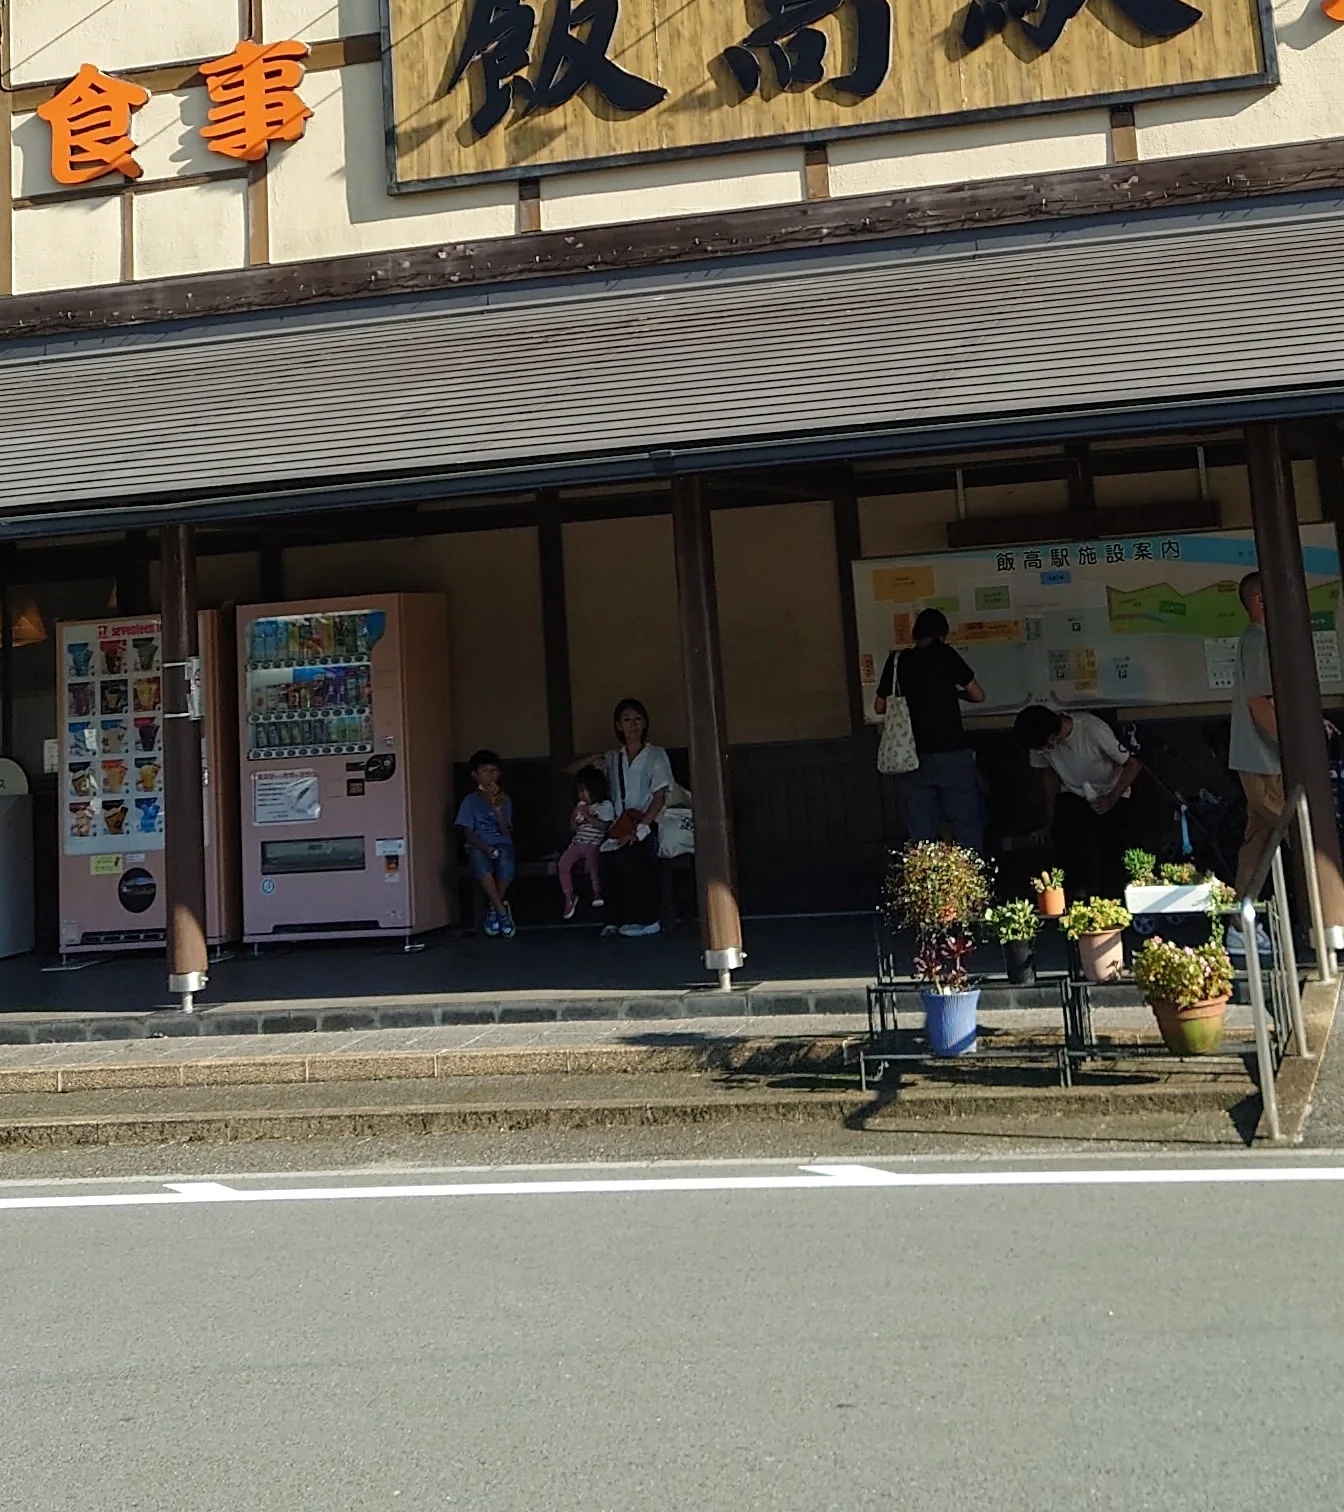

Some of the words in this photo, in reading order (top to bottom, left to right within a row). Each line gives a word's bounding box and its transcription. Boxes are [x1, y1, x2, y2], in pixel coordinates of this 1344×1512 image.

[996, 539, 1181, 572] 飯高駅施設案内
[111, 624, 155, 637] seventeen
